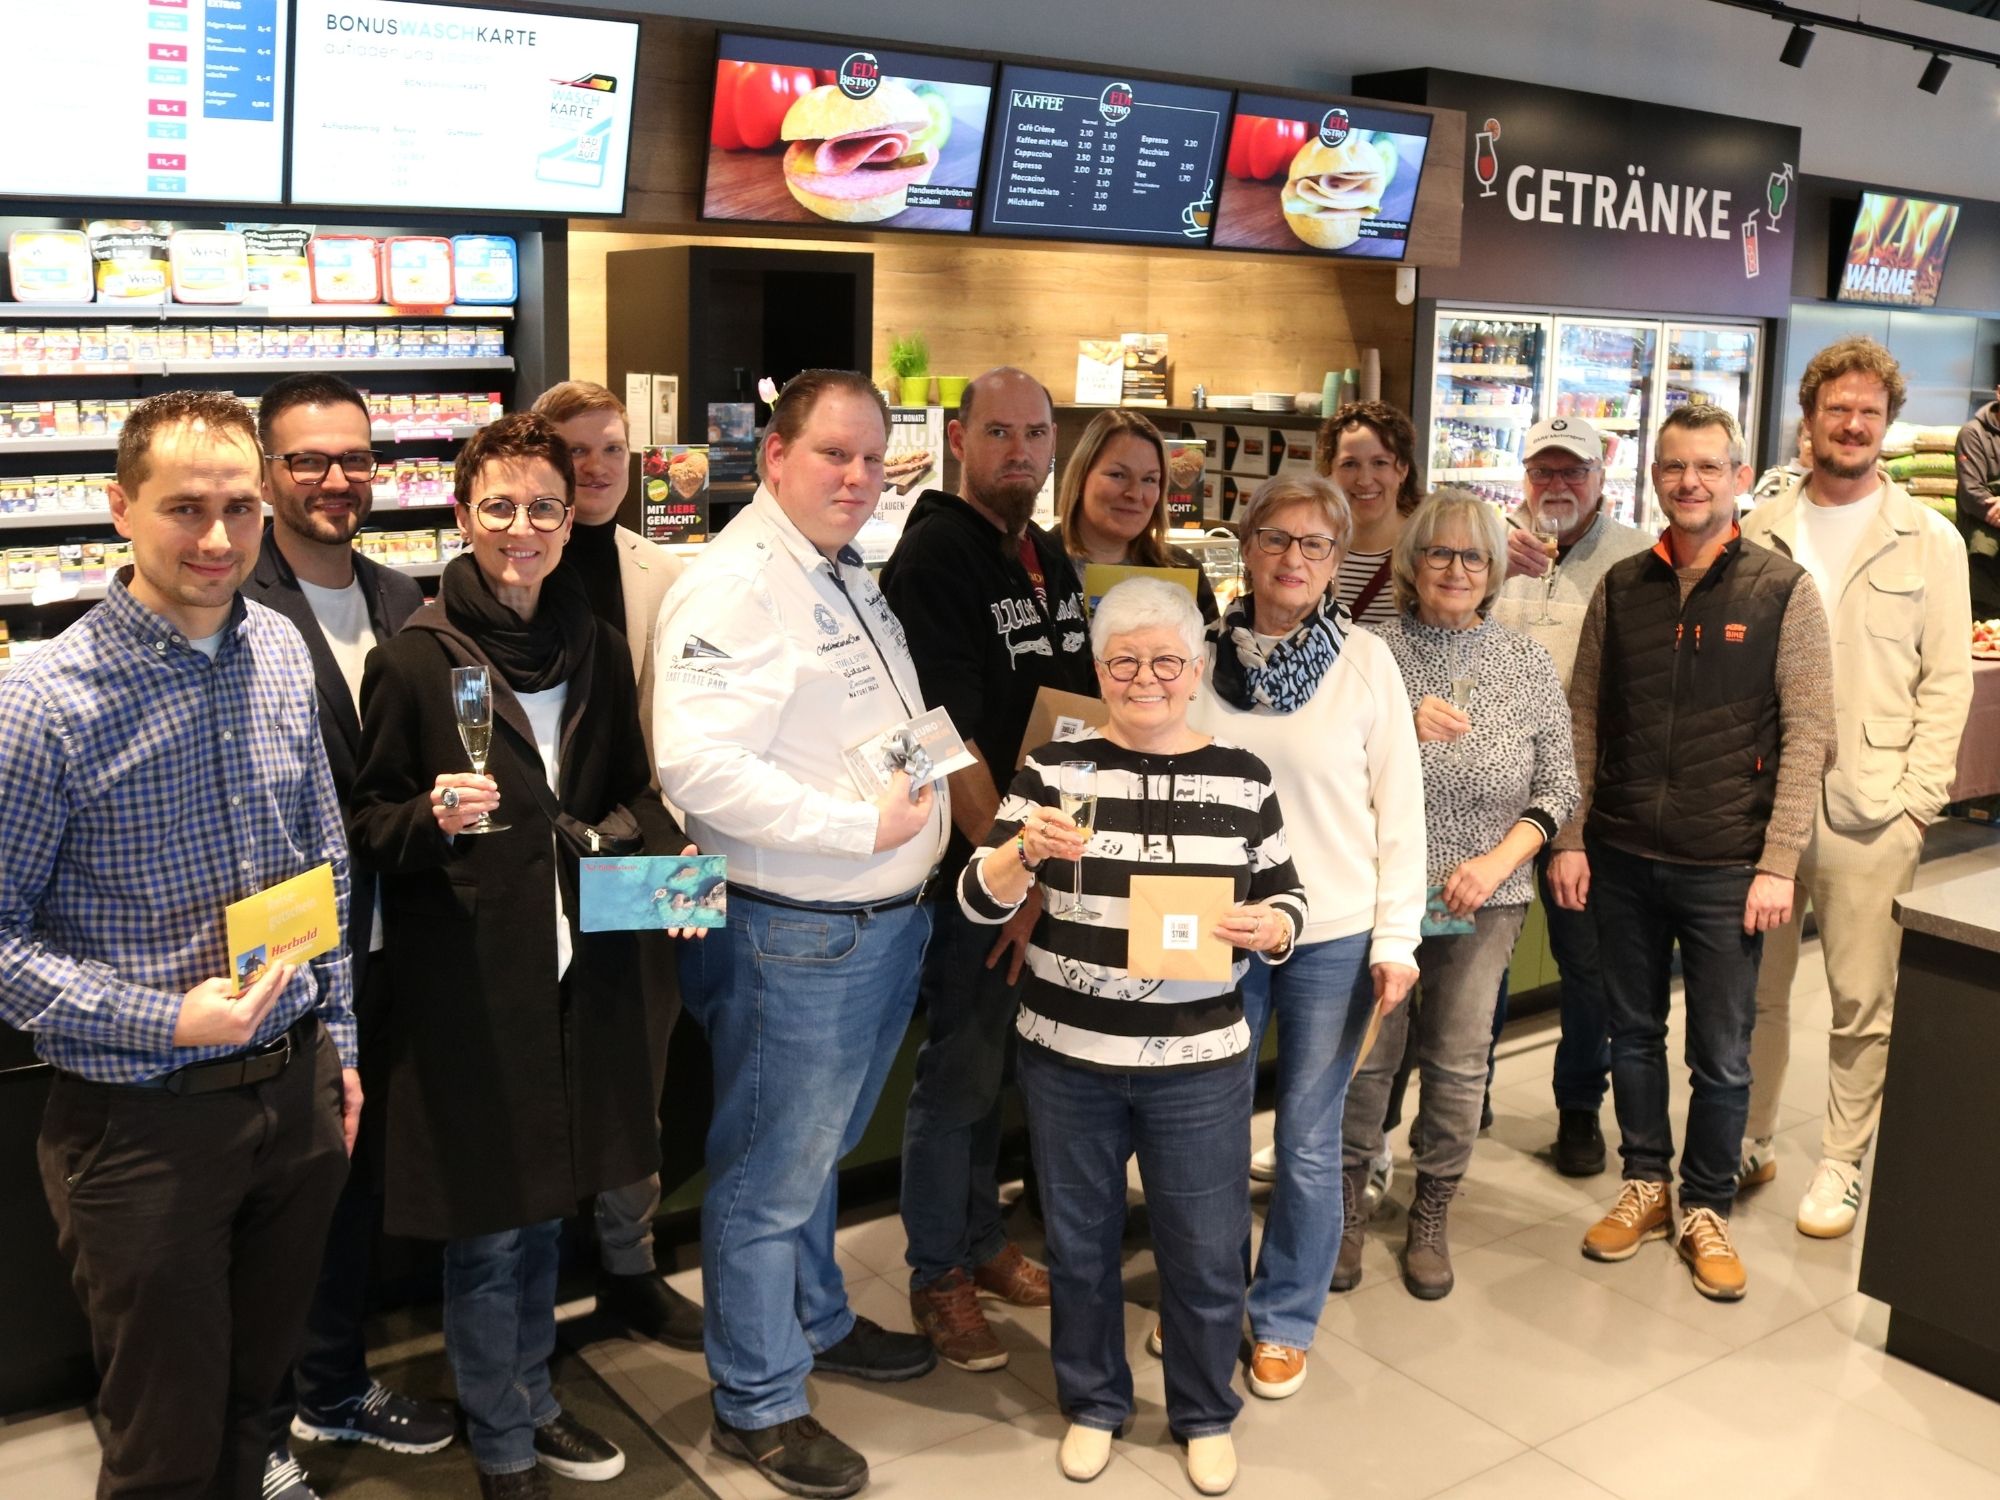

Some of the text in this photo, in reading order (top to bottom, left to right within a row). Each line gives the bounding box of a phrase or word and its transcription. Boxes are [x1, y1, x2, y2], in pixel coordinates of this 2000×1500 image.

[840, 74, 878, 89] BISTRO
[1012, 92, 1065, 111] KAFFEE
[549, 102, 594, 119] KARTE
[1014, 148, 1053, 158] Cappuccino
[1012, 160, 1043, 170] Espresso
[1009, 185, 1027, 194] Latte
[1506, 164, 1732, 241] GETRÄNKE
[1846, 256, 1918, 296] WÄRME
[891, 413, 925, 423] DES MONATS
[647, 504, 697, 515] MIT LIEBE
[646, 515, 696, 526] GEMACHT
[1170, 930, 1190, 939] STORE
